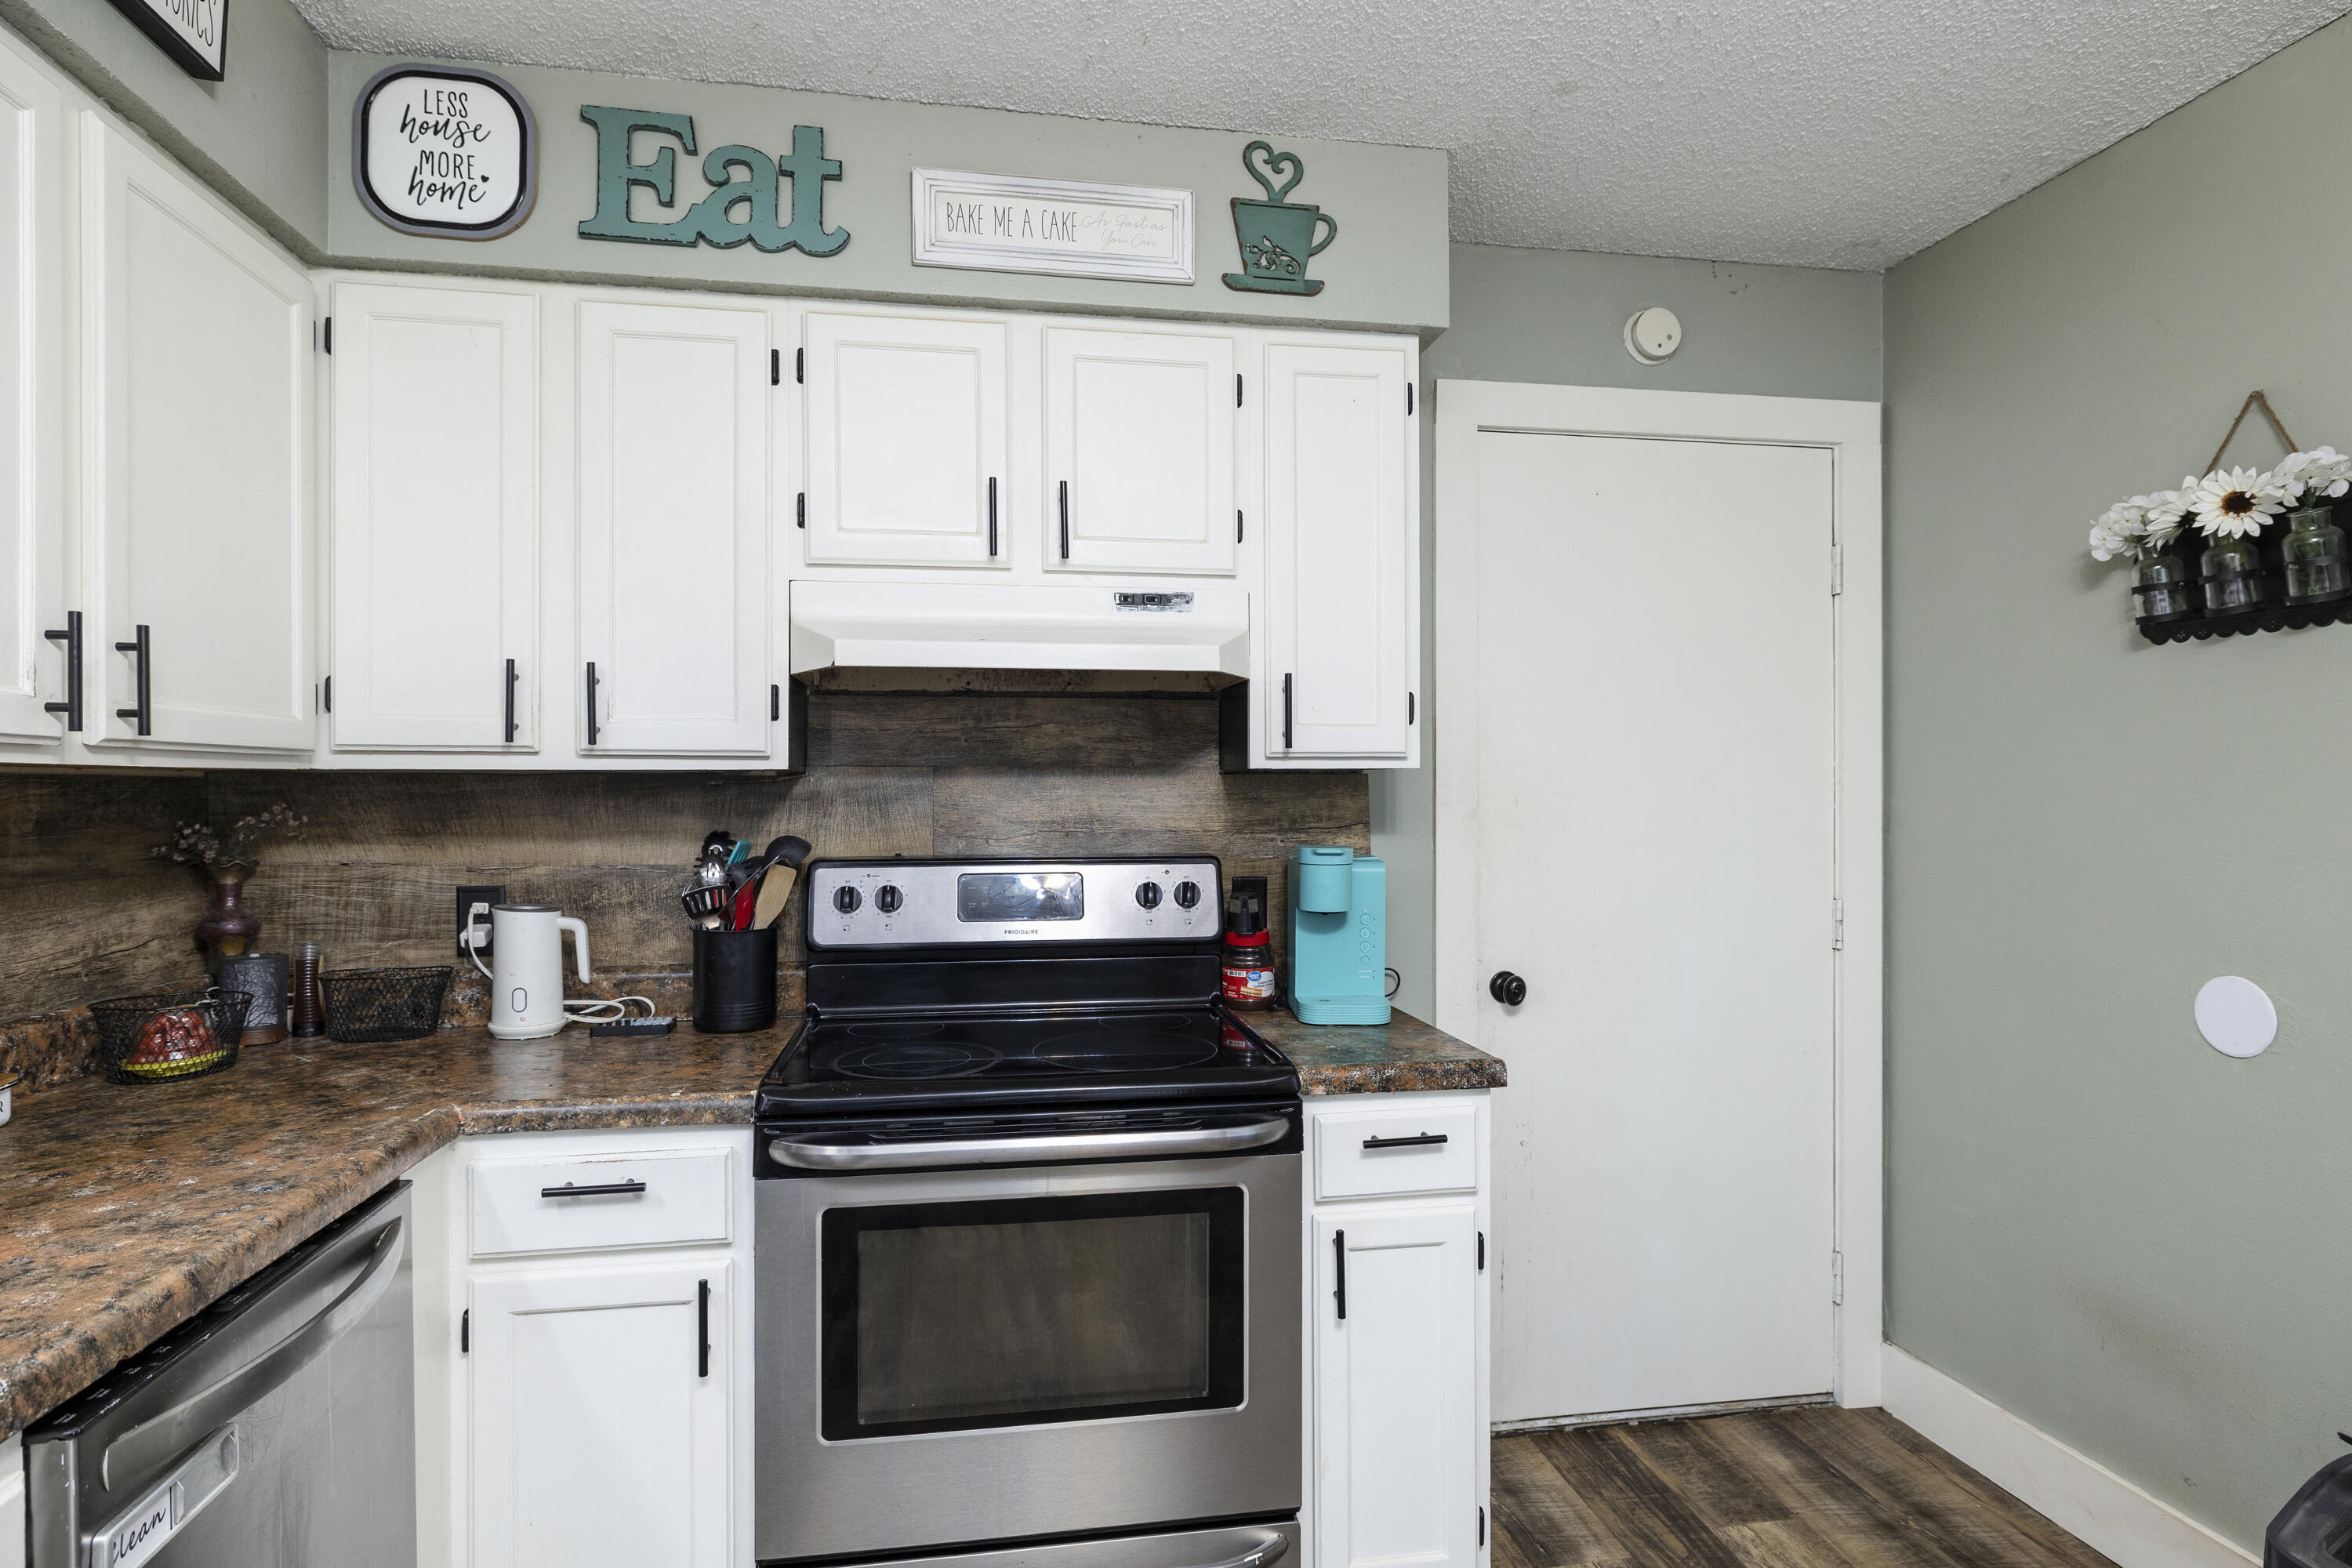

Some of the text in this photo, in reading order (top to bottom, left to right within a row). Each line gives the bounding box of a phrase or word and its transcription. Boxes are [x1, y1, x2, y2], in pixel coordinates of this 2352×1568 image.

[423, 89, 468, 118] LESS
[400, 103, 491, 148] house
[419, 149, 475, 180] MORE
[578, 104, 851, 258] Eat
[408, 165, 486, 210] home
[946, 201, 1077, 242] BAKE ME A CAKE
[1081, 211, 1112, 229] As
[1116, 213, 1149, 232] Fast
[1100, 227, 1158, 250] You Can
